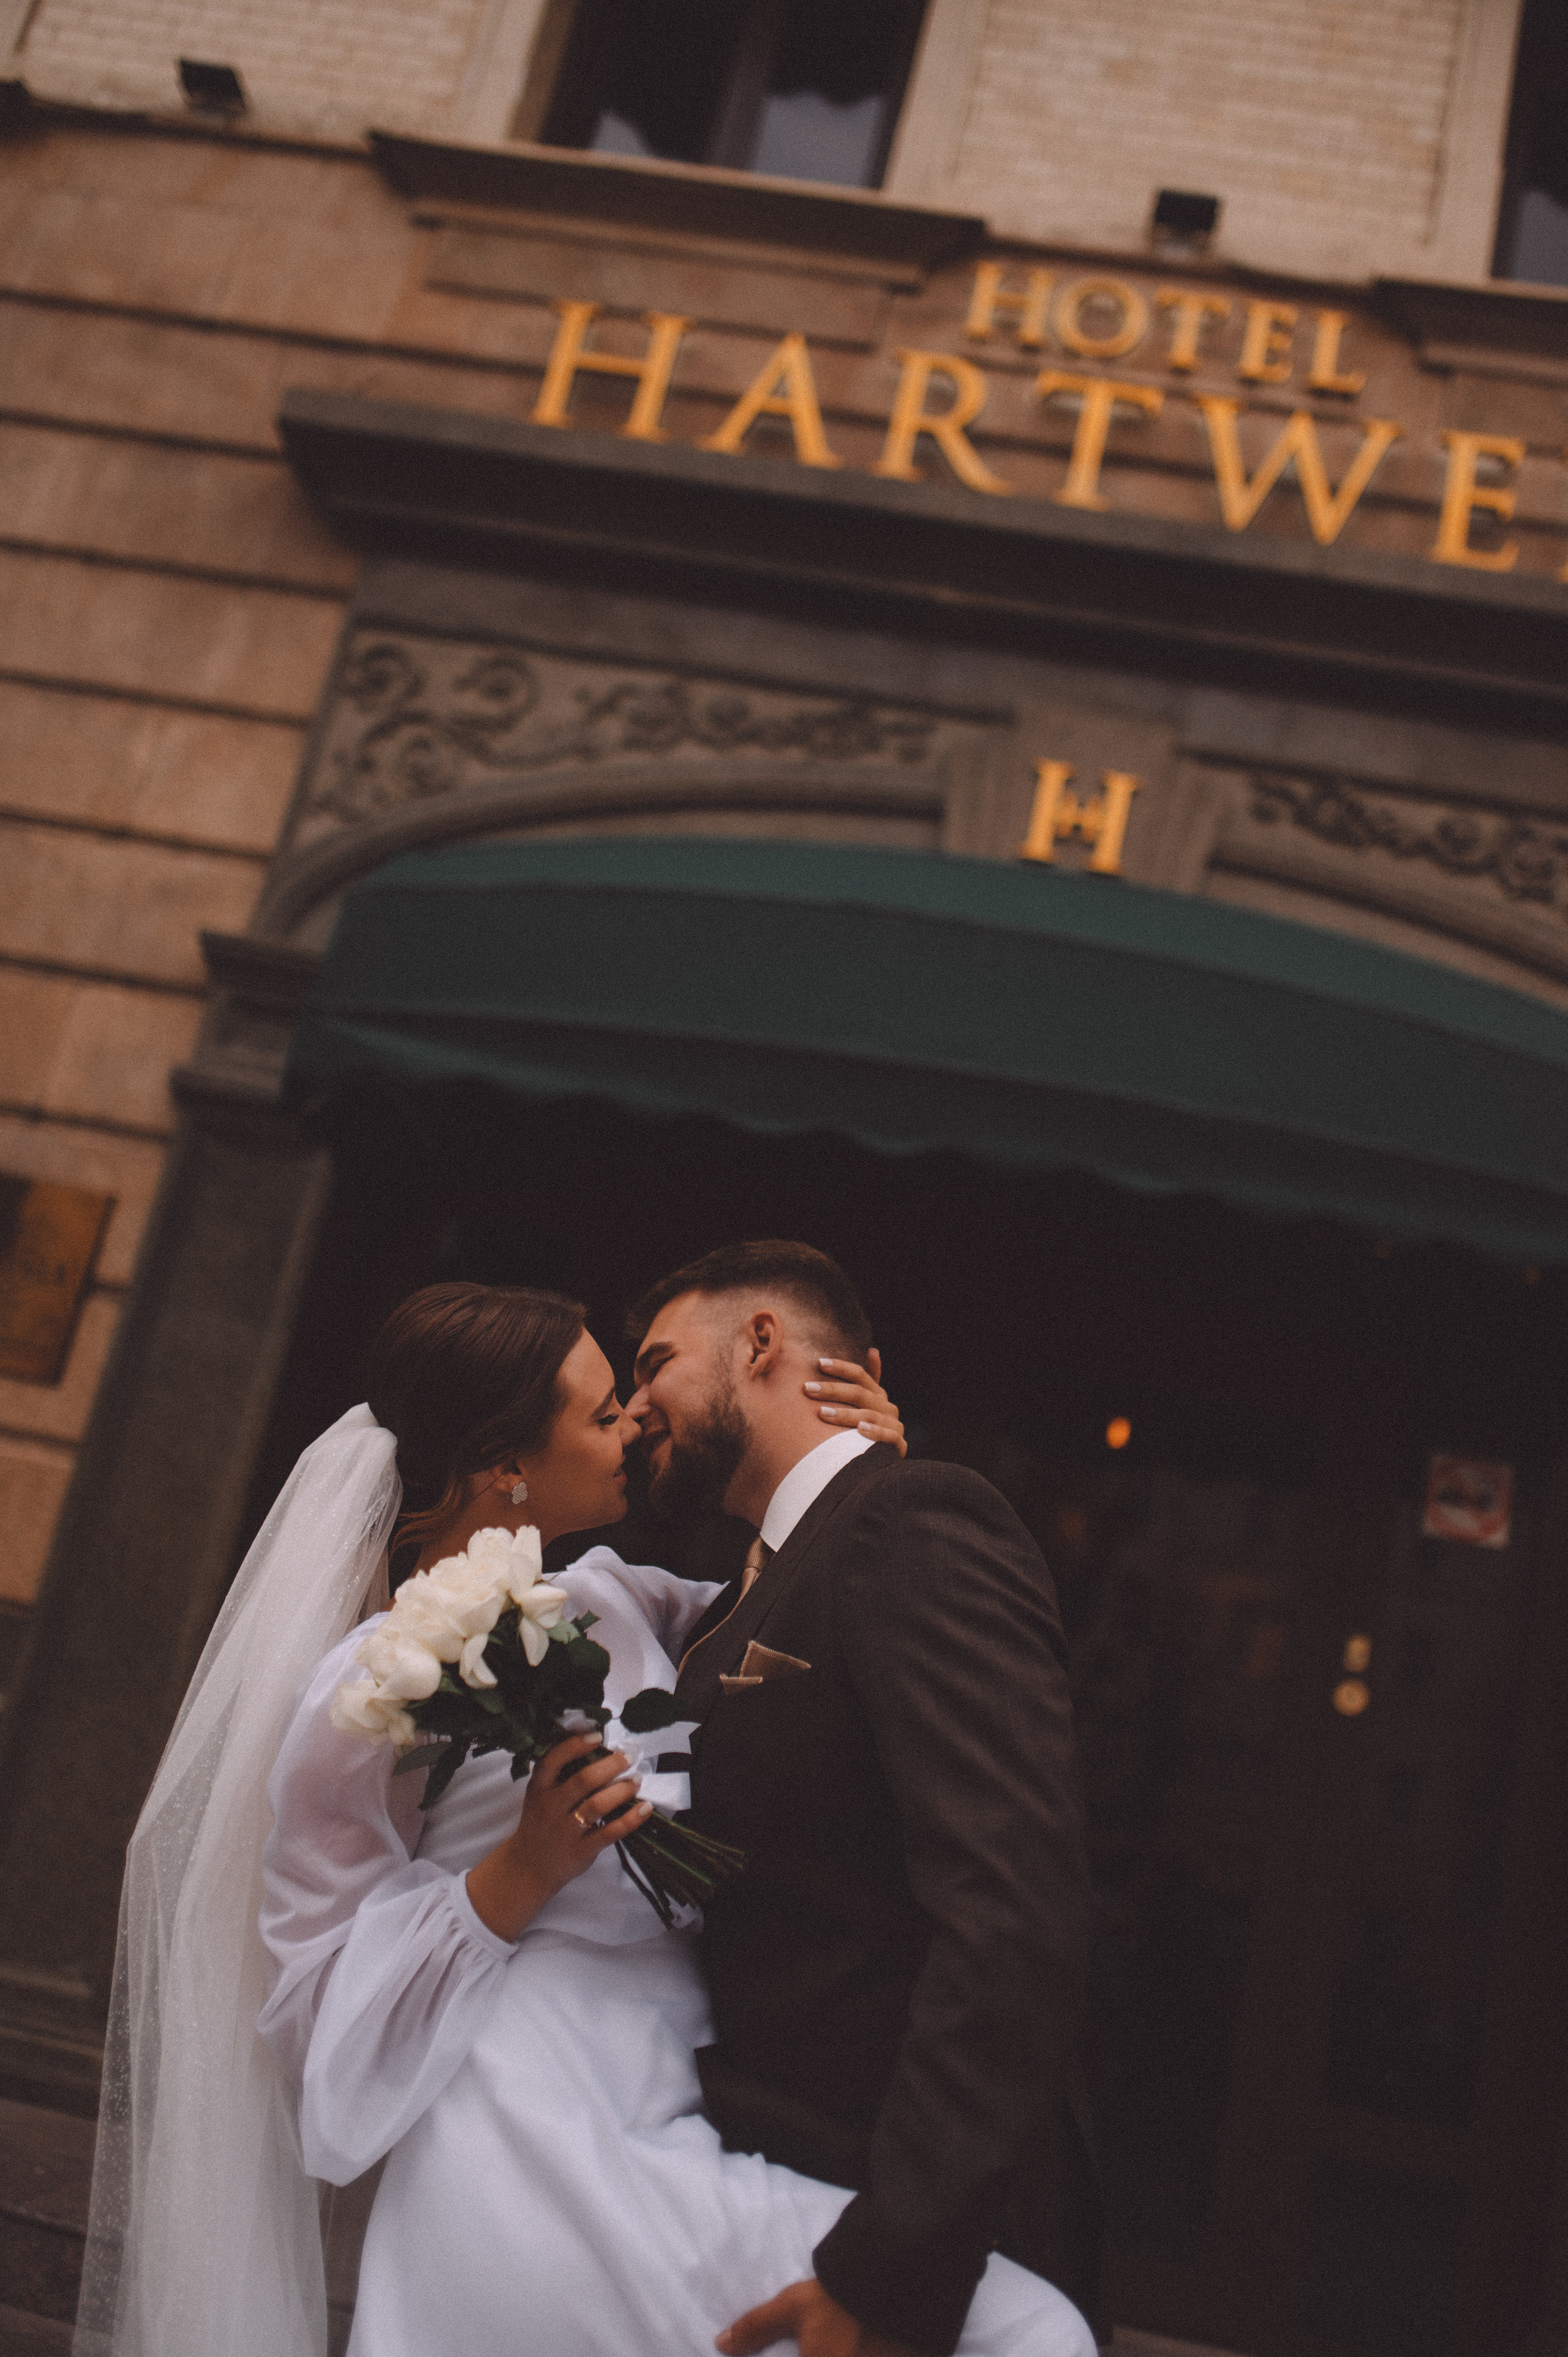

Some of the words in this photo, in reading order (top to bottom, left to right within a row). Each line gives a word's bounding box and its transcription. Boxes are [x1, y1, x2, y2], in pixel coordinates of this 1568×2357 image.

[966, 262, 1365, 393] HOTEL
[532, 300, 1568, 584] HARTWE
[1018, 757, 1143, 876] H
